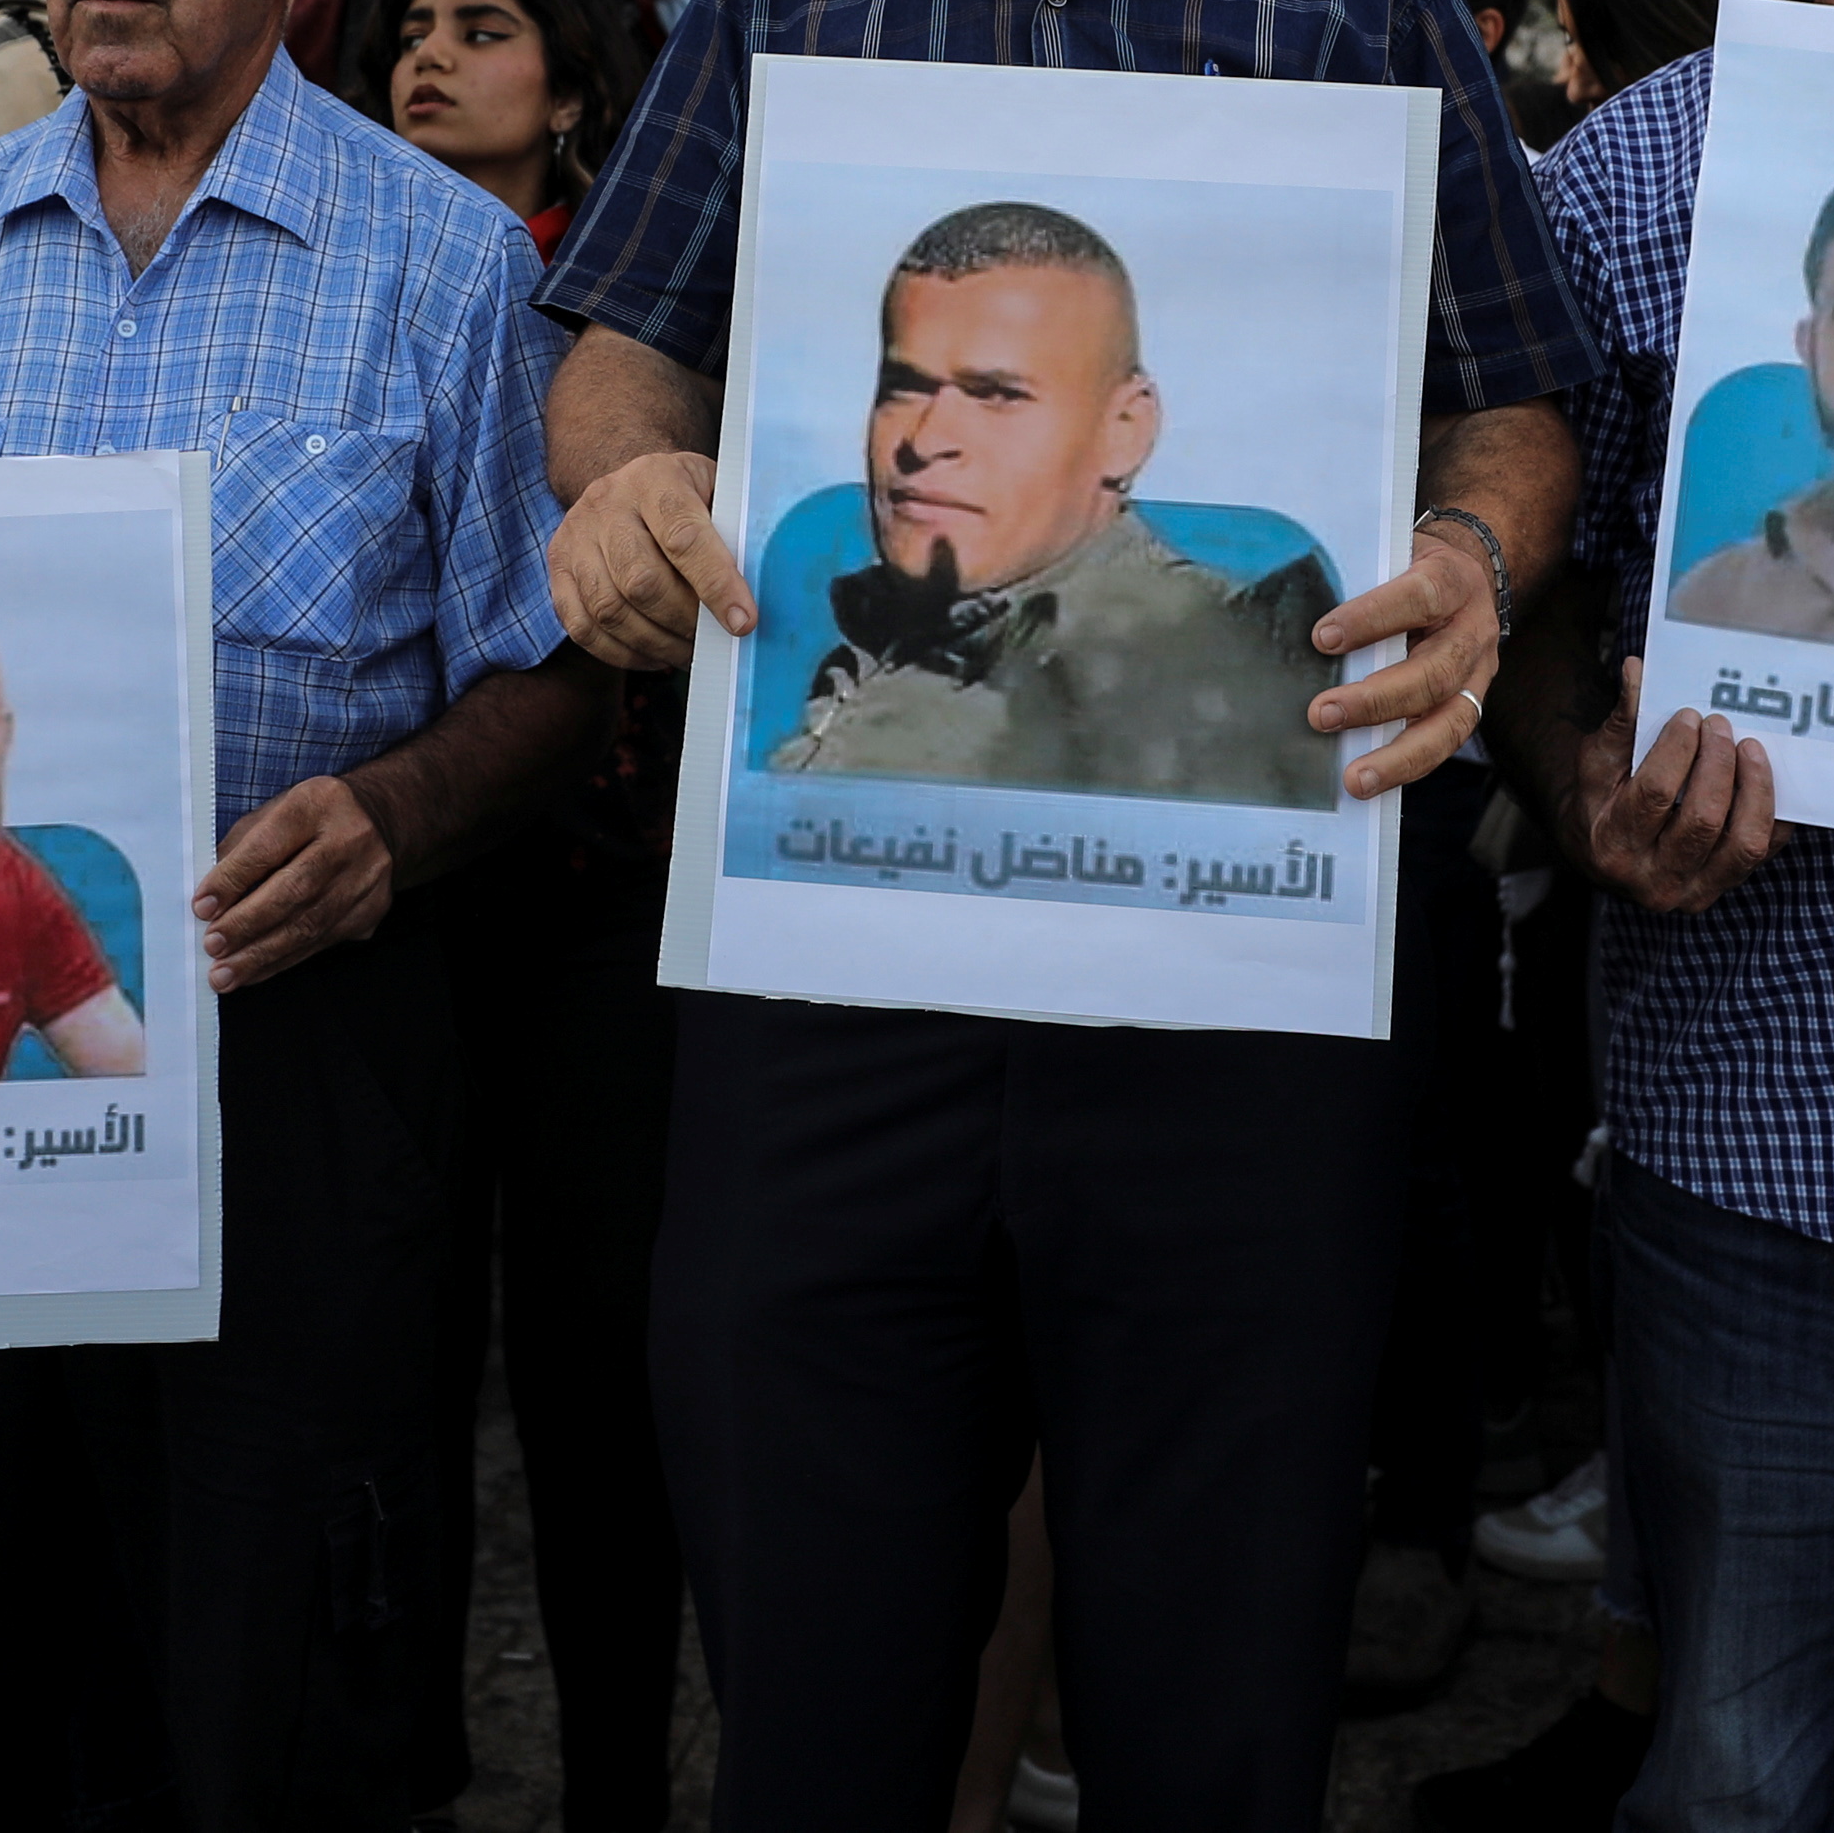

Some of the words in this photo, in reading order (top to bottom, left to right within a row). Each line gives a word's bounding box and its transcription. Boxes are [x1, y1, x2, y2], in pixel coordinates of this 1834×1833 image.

[775, 818, 957, 881] نفيعات
[969, 830, 1146, 892] مناضل
[1160, 838, 1335, 909] الأسير:
[3, 1102, 146, 1171] الأسير:
